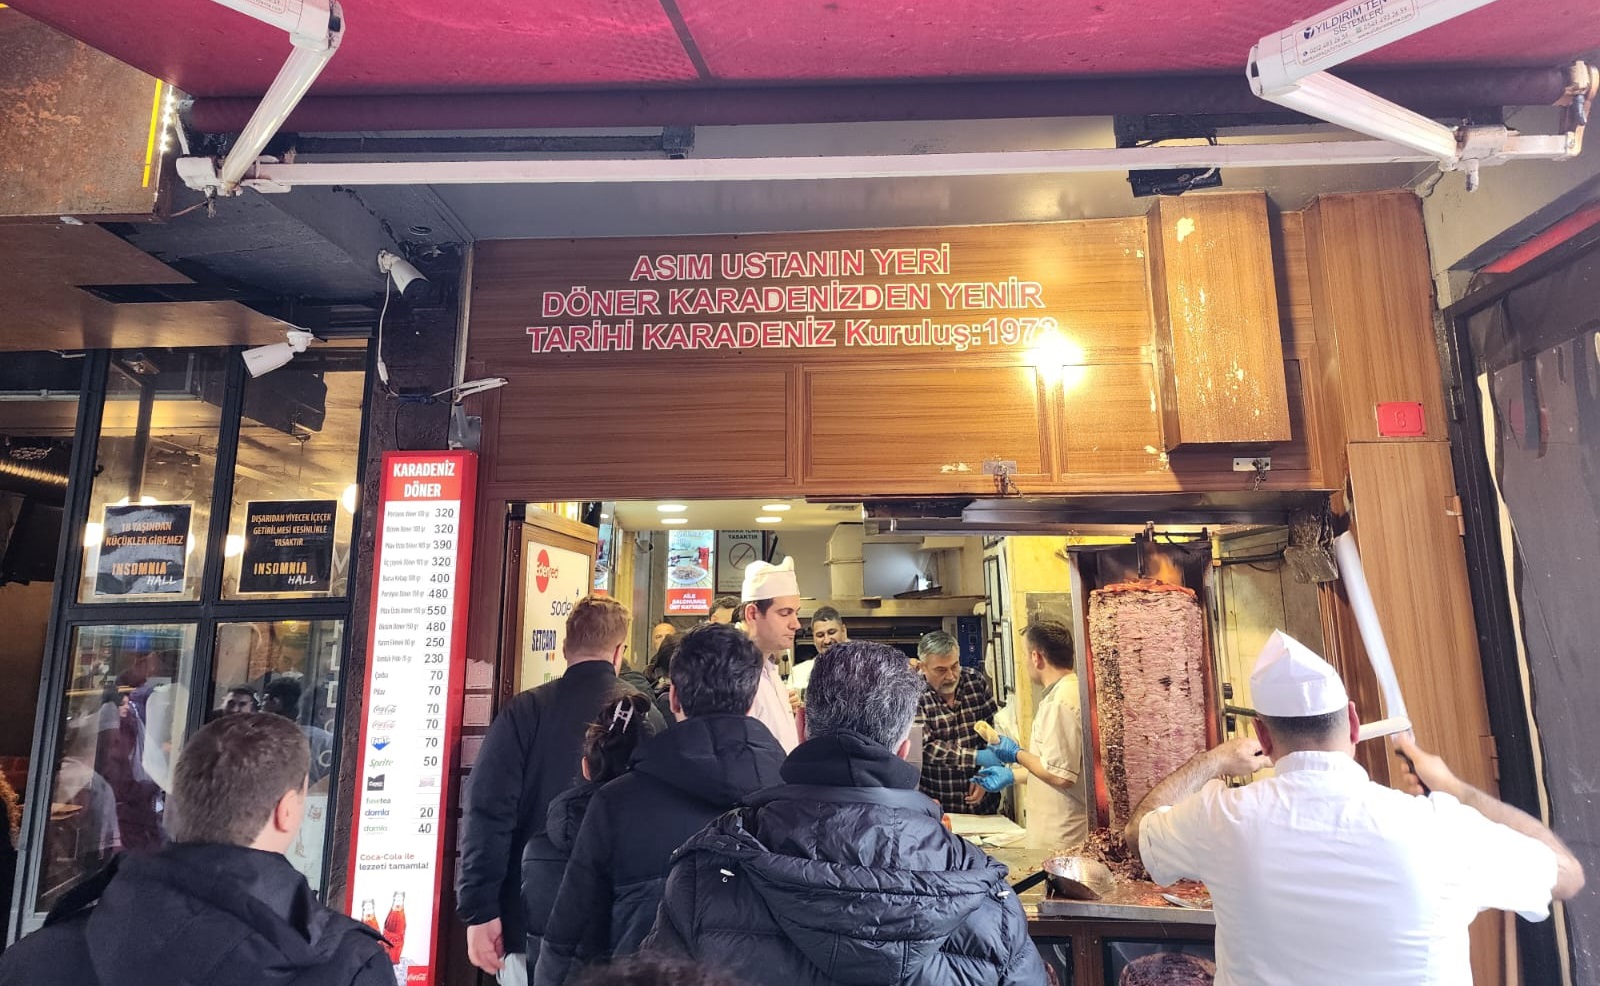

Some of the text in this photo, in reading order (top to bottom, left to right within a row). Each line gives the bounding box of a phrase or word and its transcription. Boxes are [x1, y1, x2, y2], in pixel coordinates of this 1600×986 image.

[1315, 5, 1362, 33] YILDIRIM
[630, 243, 950, 281] ASIM USTANIN YERİ
[542, 276, 1046, 318] DÖNER KARADENİZDEN YENİR
[526, 319, 634, 353] TARİHİ
[642, 315, 836, 351] KARADENİZ
[393, 459, 455, 477] KARADENİZ
[404, 480, 442, 498] DÖNER
[435, 508, 454, 518] 320
[252, 514, 284, 524] DIŞARIDAN
[132, 522, 172, 533] YAŞINDAN
[253, 524, 327, 535] GETİRİLMESİ KESİNLİKLE
[434, 524, 454, 534] 320
[106, 534, 184, 548] KÜÇÜKLER GİREMEZ
[433, 540, 452, 550] 390
[432, 557, 451, 566] 320
[112, 562, 167, 576] INSOMNIA
[254, 562, 307, 575] INSOMNIA
[146, 575, 176, 586] HALL
[288, 575, 317, 585] HALL
[430, 574, 450, 583] 400
[429, 589, 448, 598] 480
[427, 606, 446, 615] 550
[426, 622, 446, 632] 480
[426, 638, 445, 647] 250
[532, 630, 556, 652] SETCARD
[424, 654, 444, 664] 230
[430, 670, 443, 680] 70
[428, 686, 441, 695] 70
[427, 703, 439, 714] 70
[426, 719, 439, 729] 70
[425, 738, 438, 747] 70
[369, 756, 438, 768] Sprite 50
[420, 807, 433, 818] 20
[418, 823, 432, 834] 40
[360, 853, 401, 861] Coca-Cola
[389, 862, 429, 870] tamamla!
